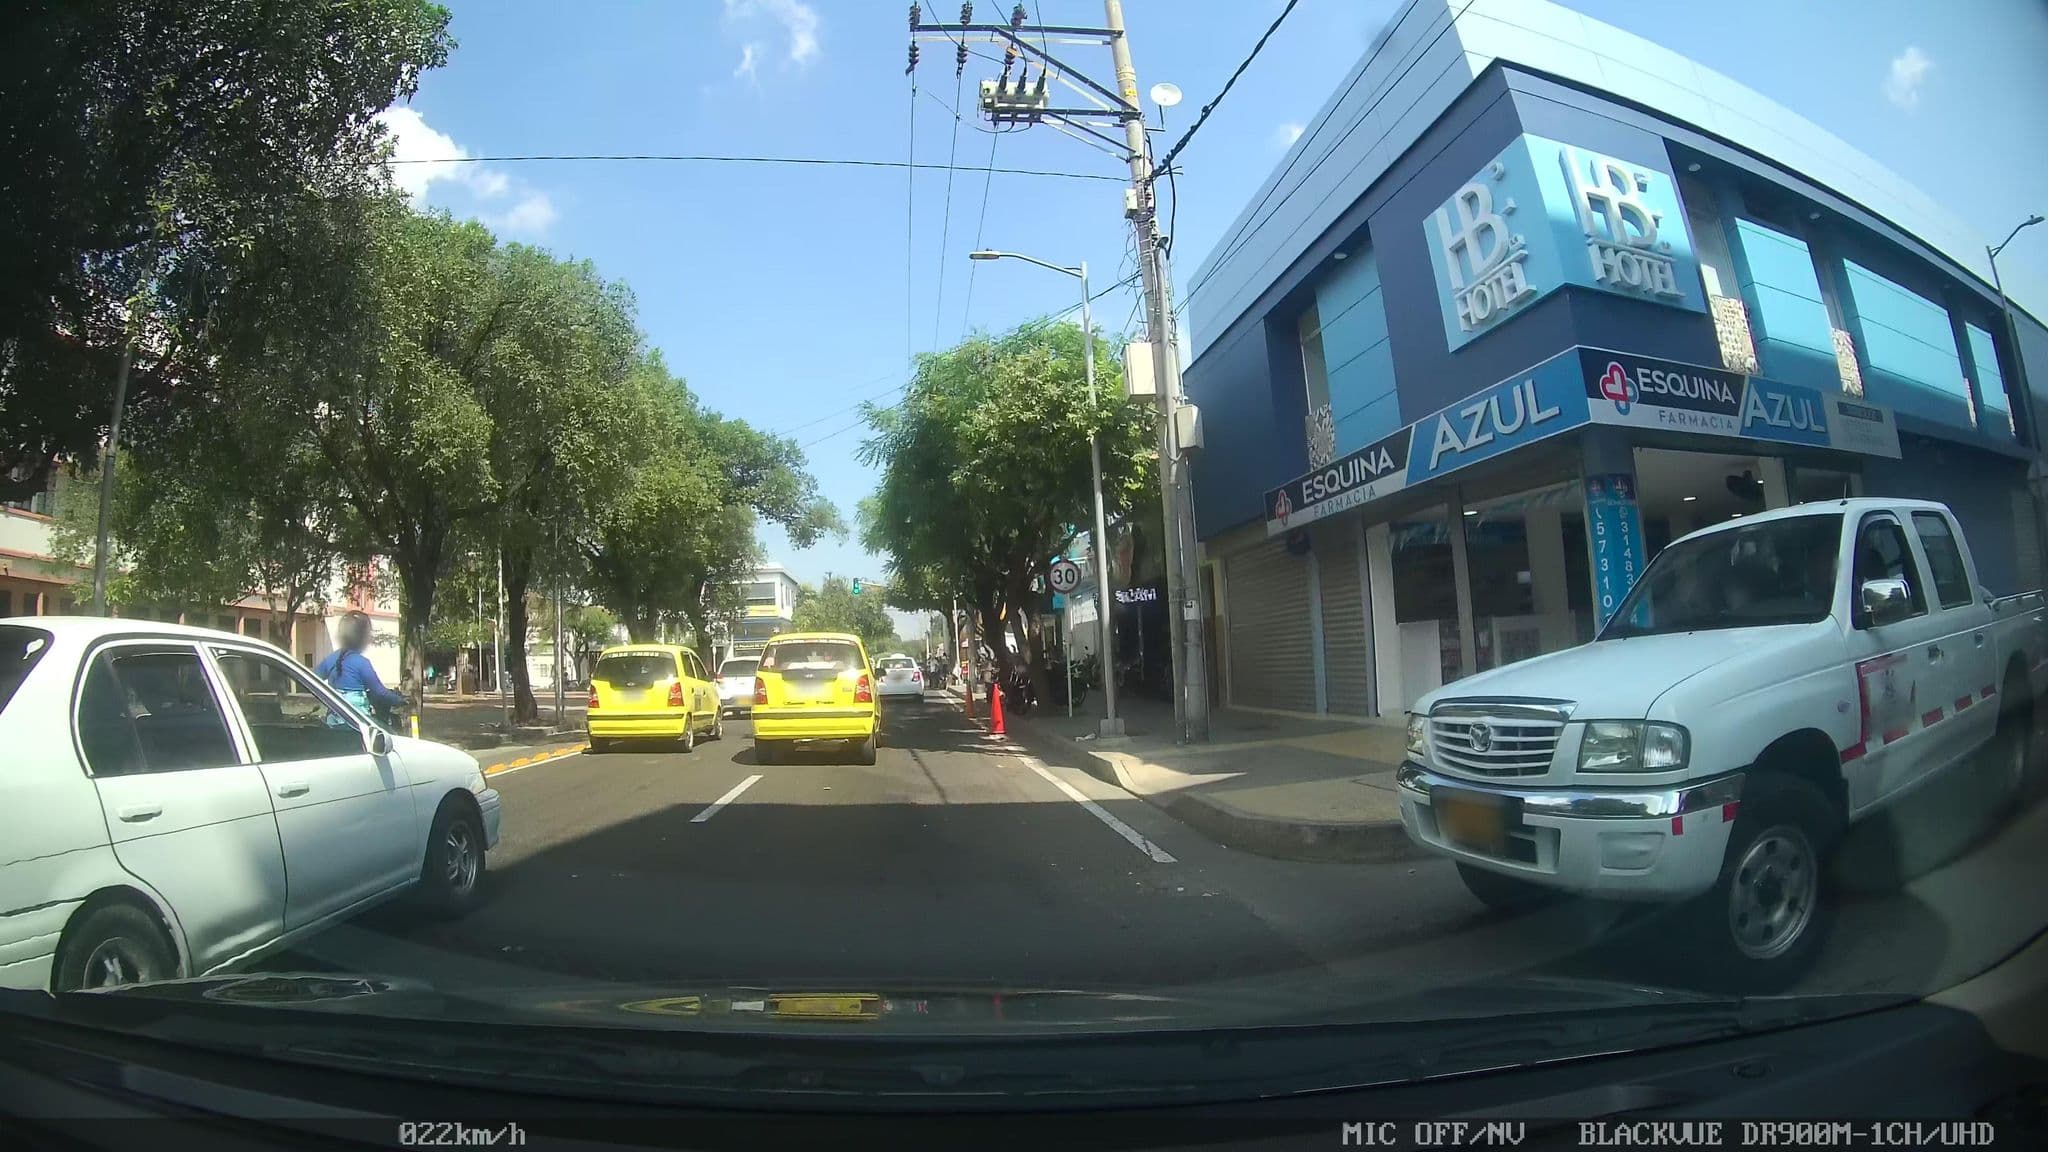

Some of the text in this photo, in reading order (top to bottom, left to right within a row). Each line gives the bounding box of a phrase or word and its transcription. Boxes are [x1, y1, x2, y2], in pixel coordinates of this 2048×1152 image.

[1456, 262, 1537, 331] HOTEL
[1587, 244, 1687, 298] HOTEL
[1636, 367, 1736, 405] ESQUINA
[1744, 384, 1826, 433] AZUL
[1658, 409, 1734, 430] FARMACIA
[1302, 379, 1560, 504] ESQUINA AZUL
[1313, 484, 1377, 518] FARMACIA
[1053, 569, 1076, 584] 30
